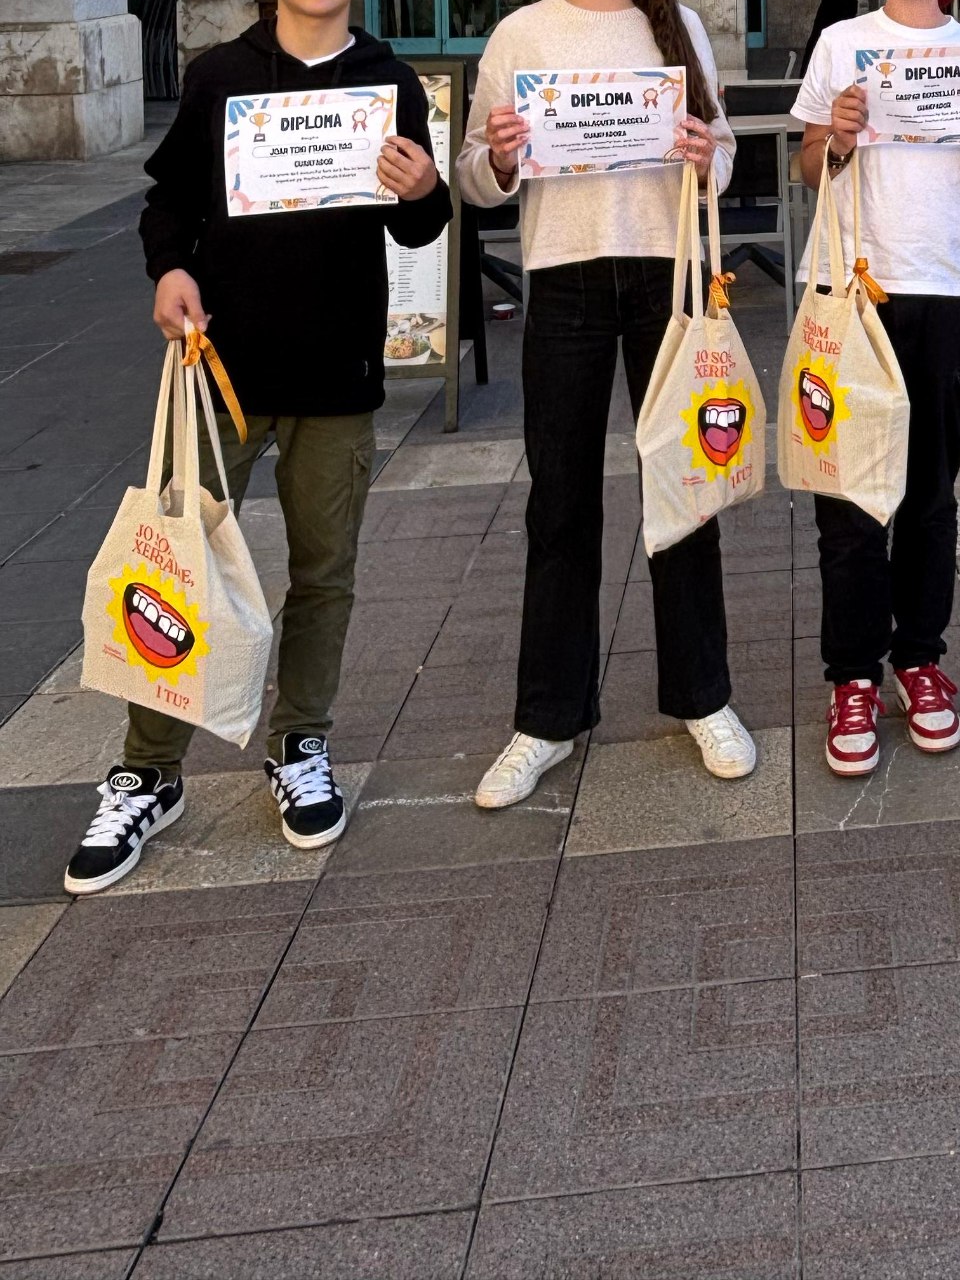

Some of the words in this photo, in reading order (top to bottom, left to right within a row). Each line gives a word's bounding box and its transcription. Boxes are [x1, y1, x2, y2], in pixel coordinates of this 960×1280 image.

[905, 65, 960, 81] DIPLOMA
[571, 91, 633, 108] DIPLOMA
[280, 113, 342, 131] DIPLOMA
[136, 524, 153, 541] JO
[162, 689, 190, 710] TU?
